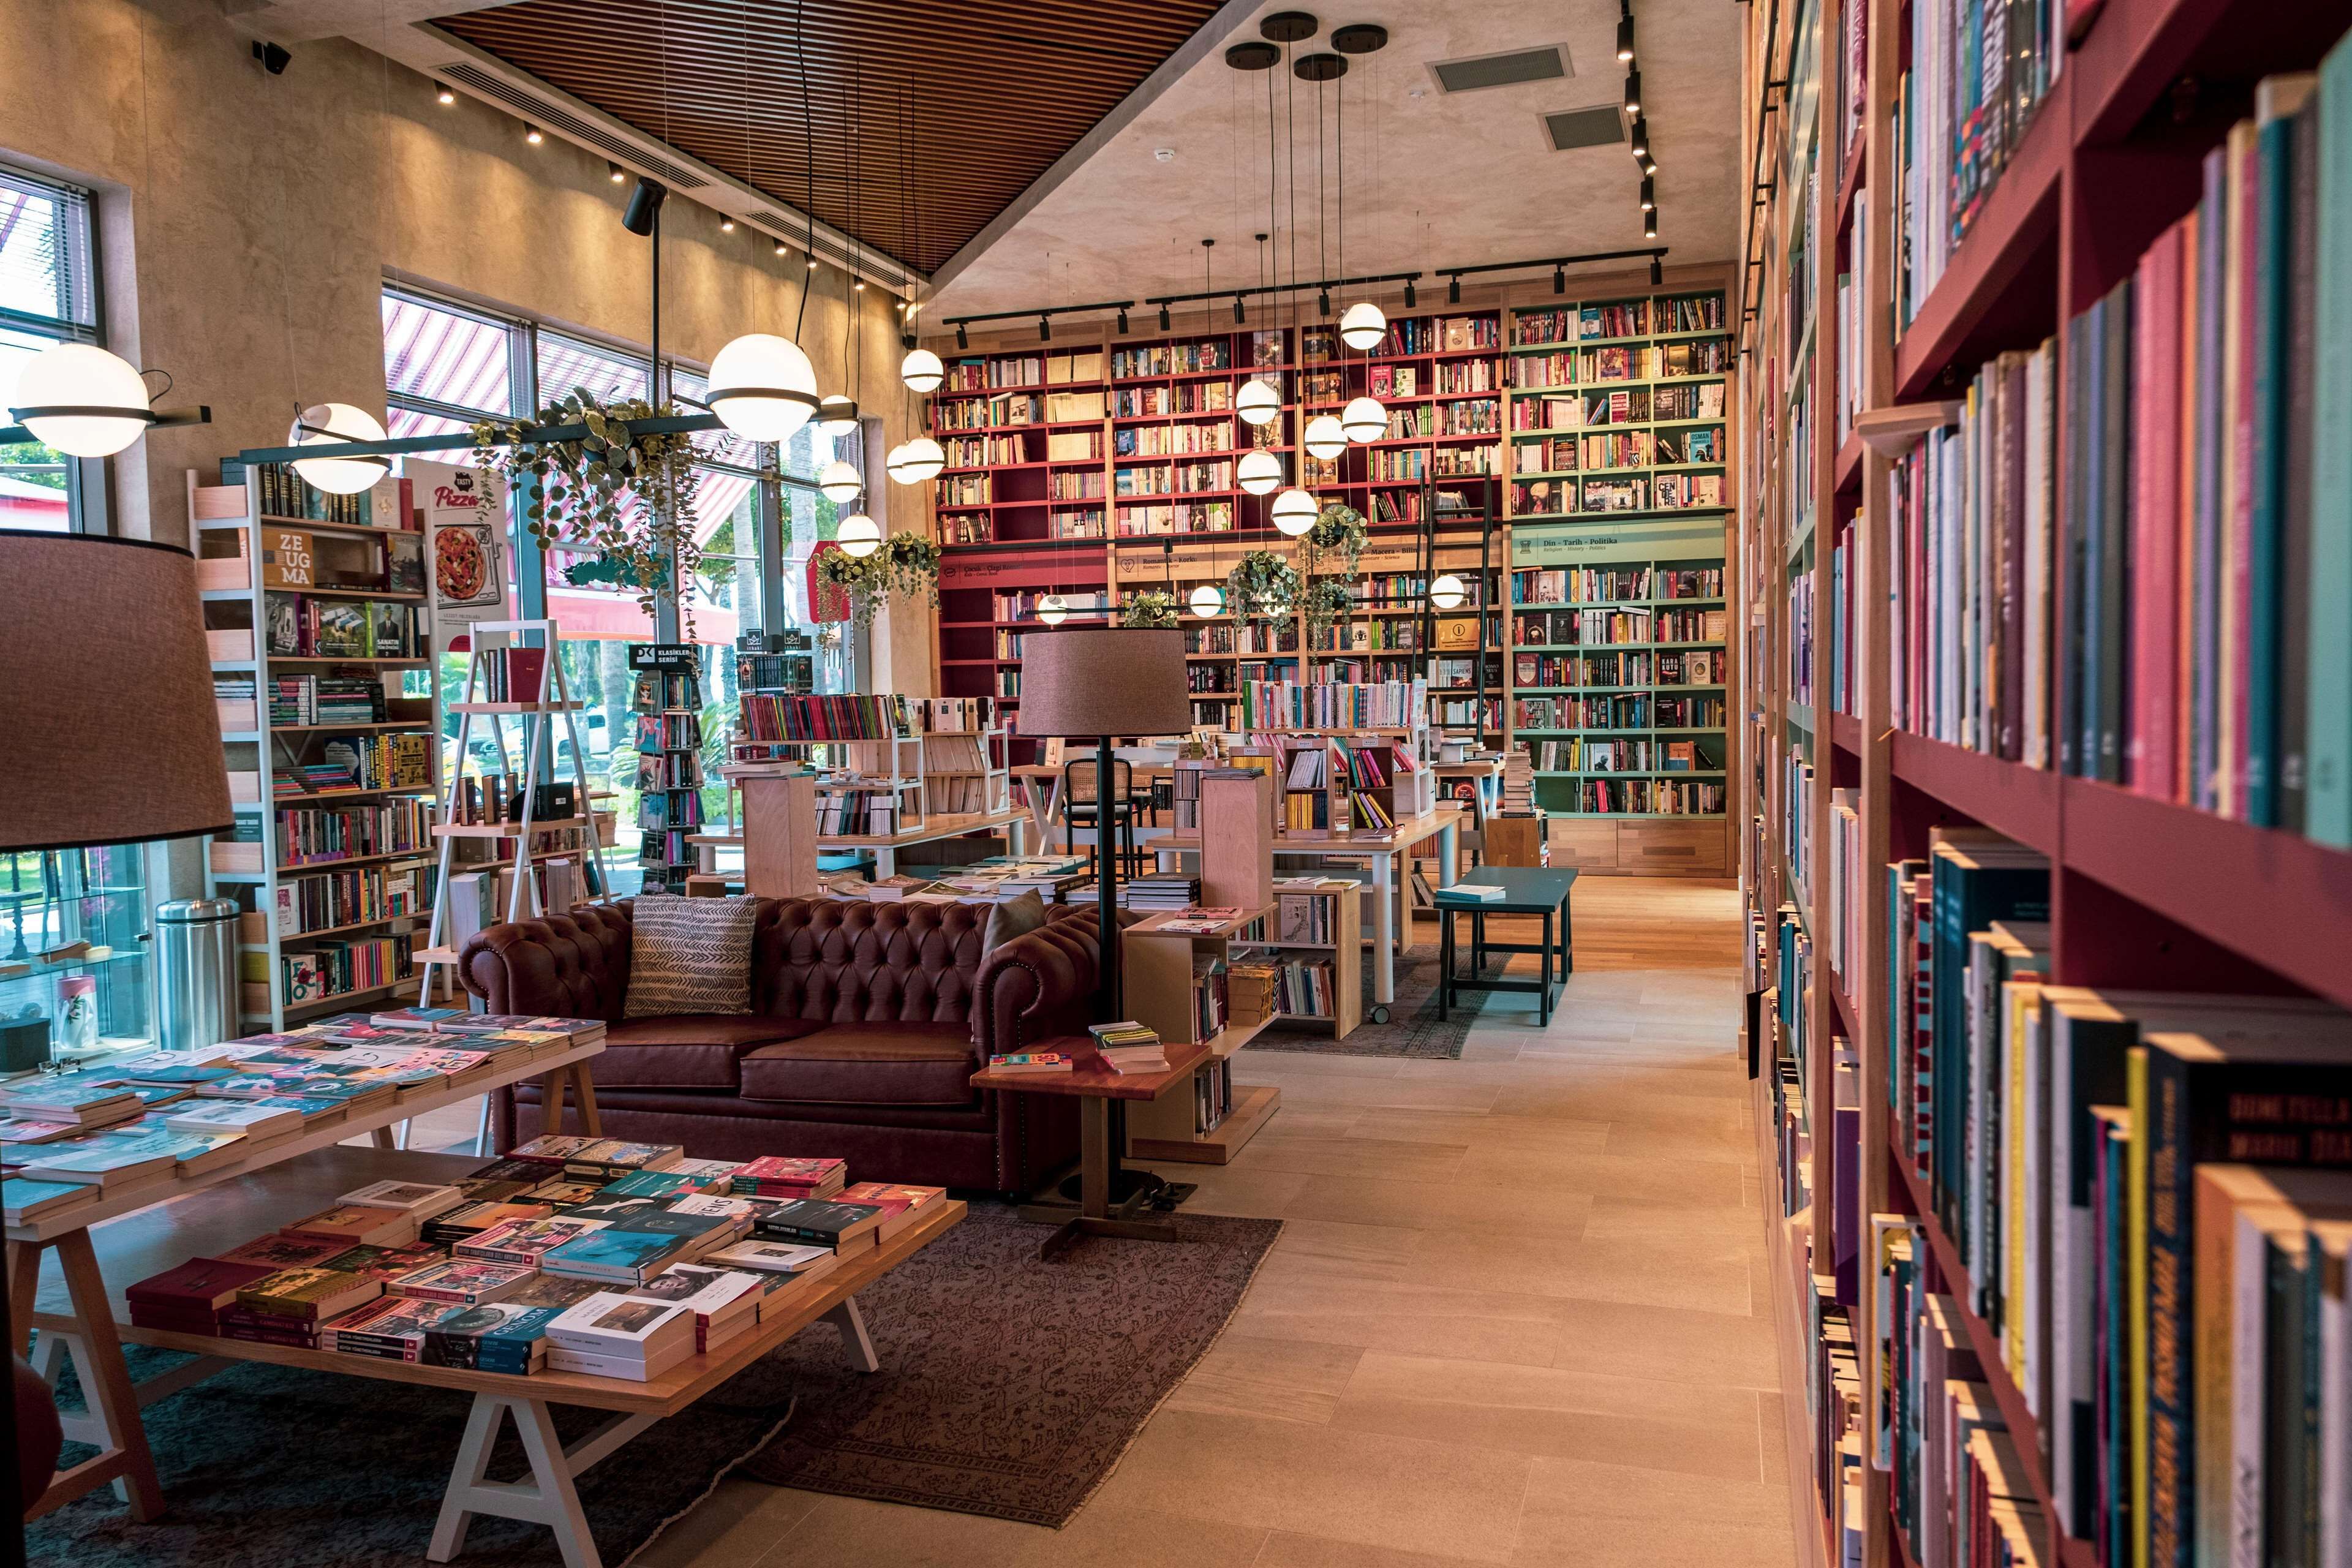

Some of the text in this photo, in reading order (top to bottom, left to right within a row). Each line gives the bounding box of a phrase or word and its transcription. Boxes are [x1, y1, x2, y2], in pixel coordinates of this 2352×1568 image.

[1659, 482, 1676, 491] CEN
[434, 486, 480, 508] Pizza
[1664, 497, 1676, 505] RE
[280, 533, 303, 551] ZE
[285, 552, 311, 568] UG
[282, 568, 310, 584] MA
[435, 1201, 479, 1221] Livaneli
[494, 1308, 549, 1335] GENOM
